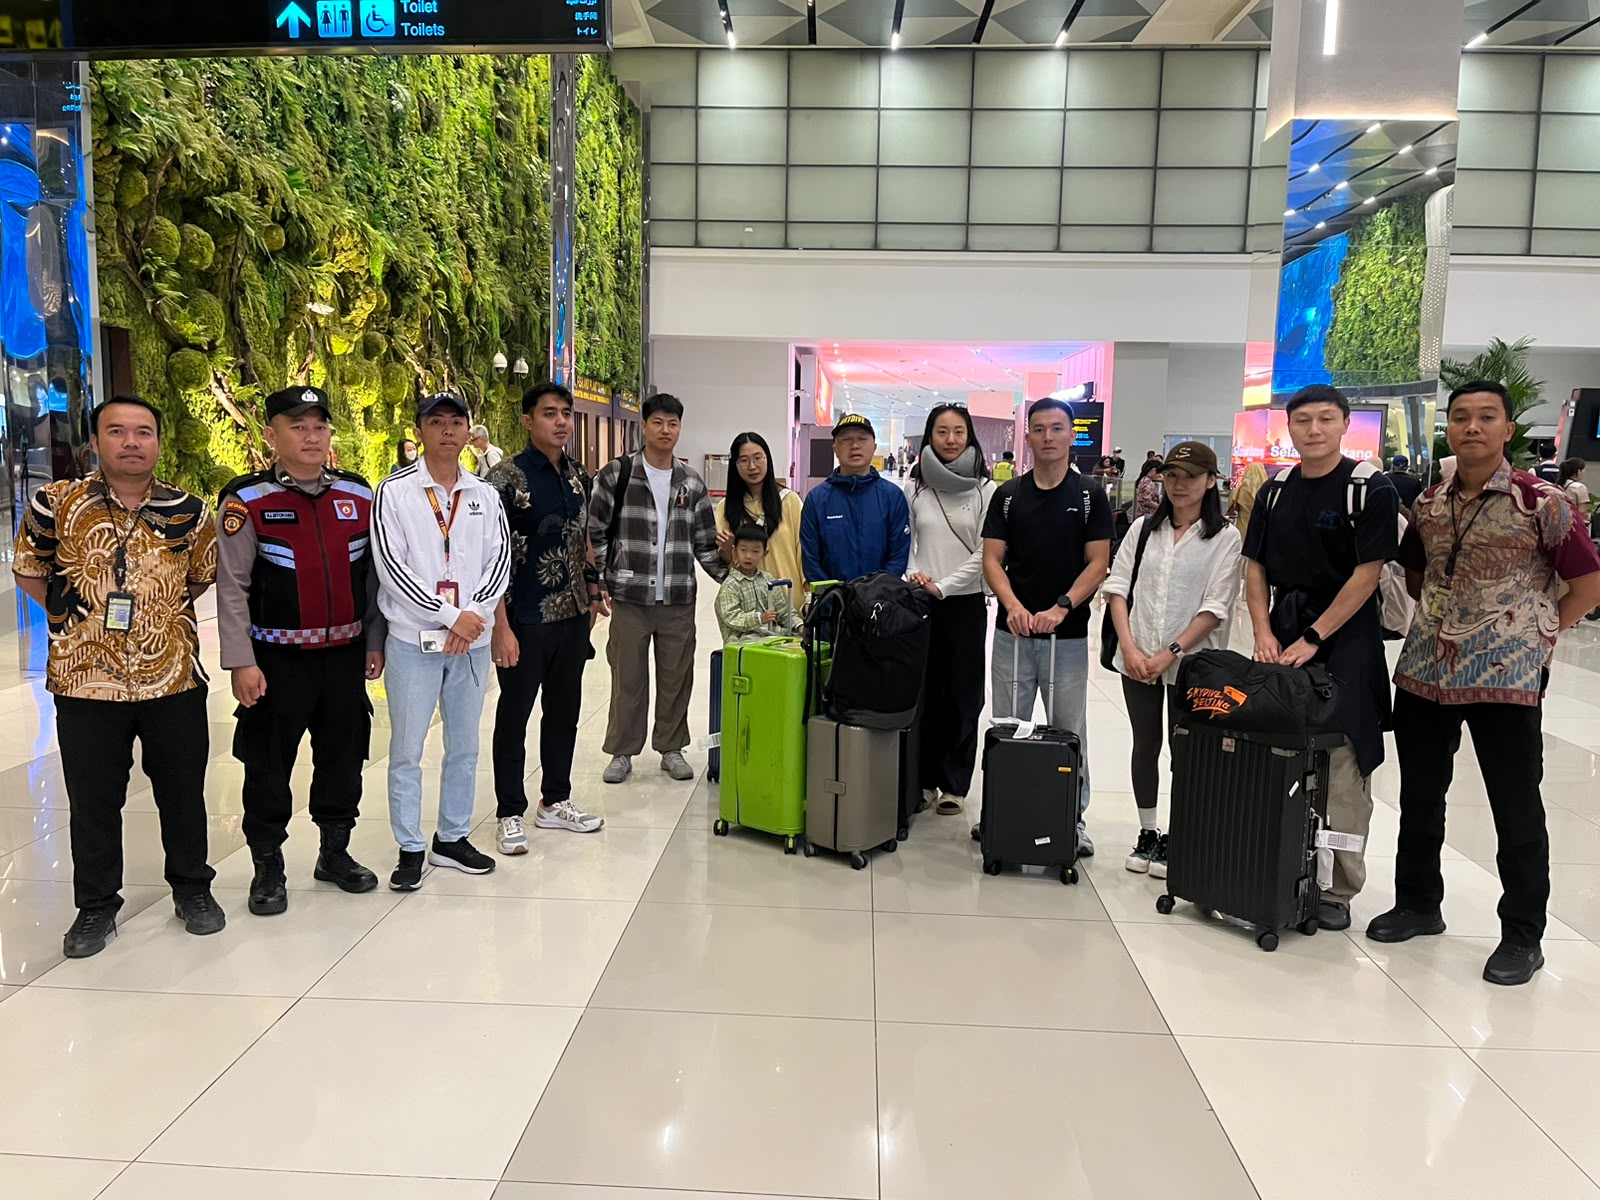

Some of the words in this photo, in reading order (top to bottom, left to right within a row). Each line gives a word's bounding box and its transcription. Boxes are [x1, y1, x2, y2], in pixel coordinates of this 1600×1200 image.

[400, 0, 438, 13] Toilet
[400, 22, 445, 36] Toilets
[577, 27, 598, 36] トイレ
[1270, 445, 1301, 457] Sela
[1340, 449, 1373, 461] tang
[1186, 687, 1223, 700] SKYDIVE
